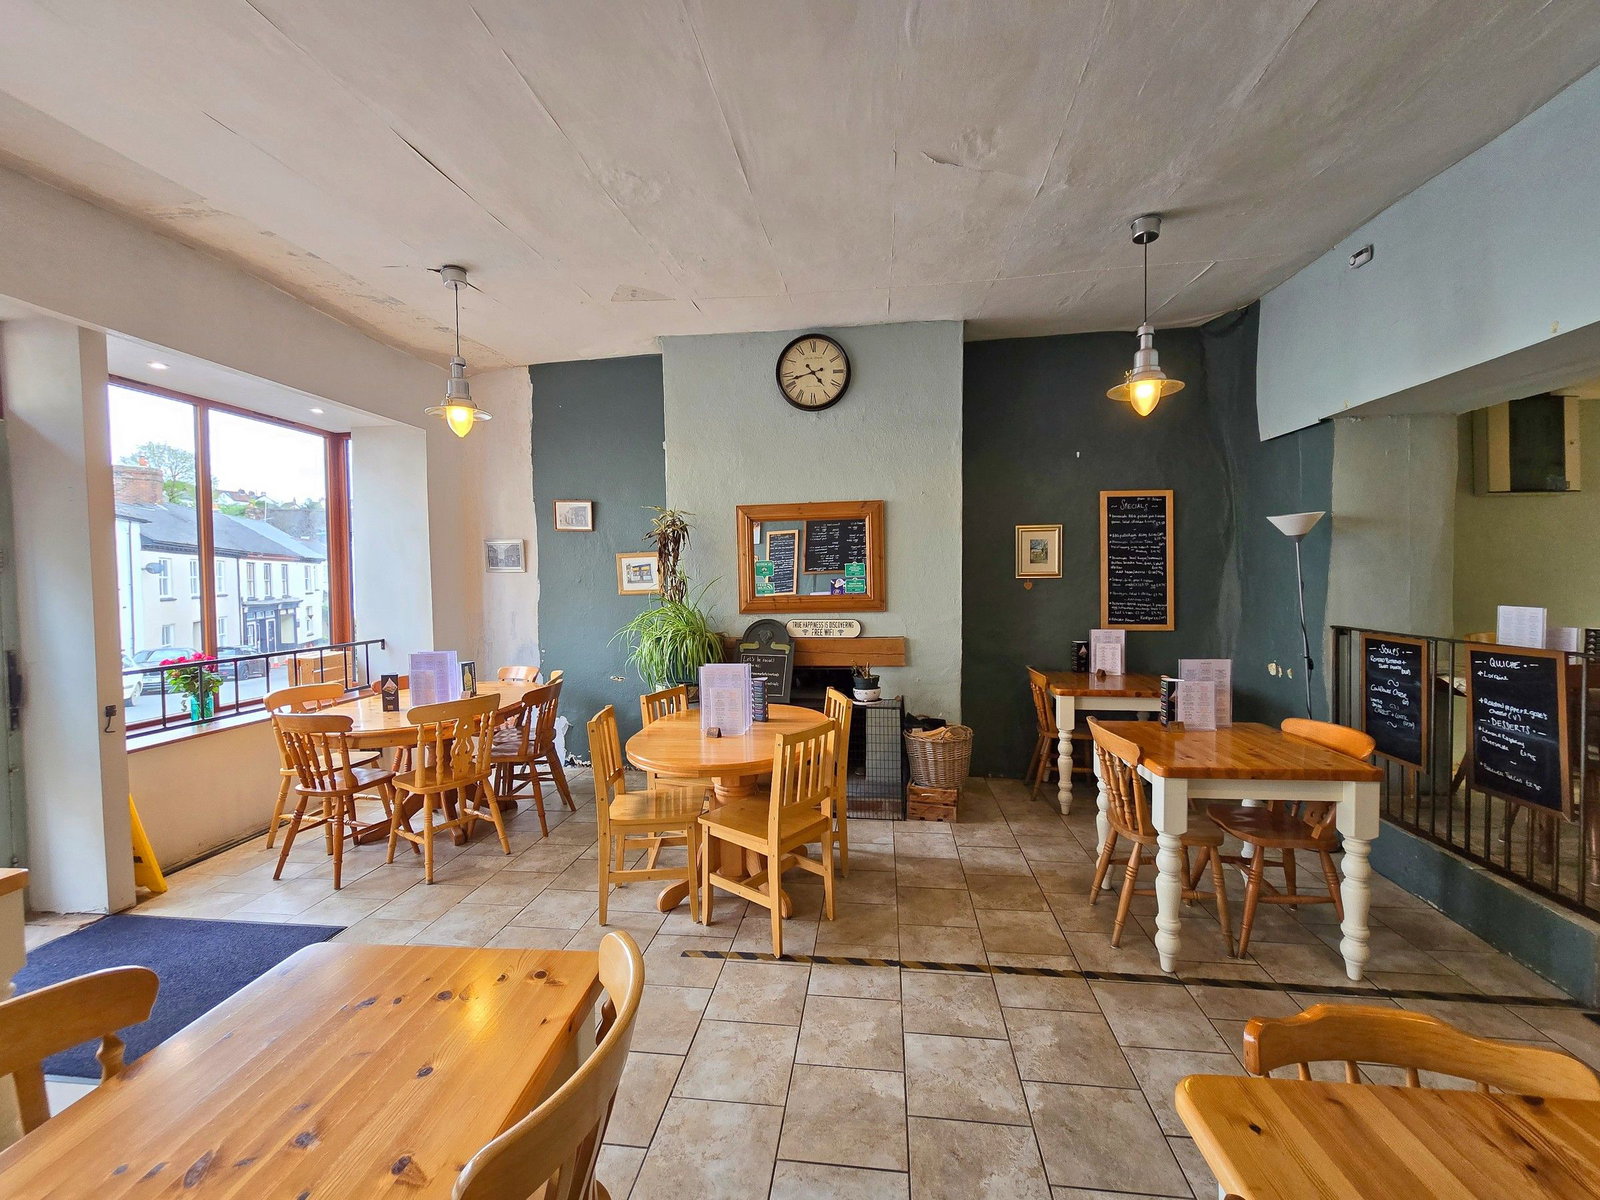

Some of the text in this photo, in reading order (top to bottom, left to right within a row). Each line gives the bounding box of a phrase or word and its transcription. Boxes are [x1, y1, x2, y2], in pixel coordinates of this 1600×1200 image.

[792, 621, 855, 629] TRUE HAPPINESS IS DISCOVERING
[811, 628, 823, 636] FREE
[1489, 657, 1521, 670] QUICHE
[1490, 717, 1531, 735] DESSERTS
